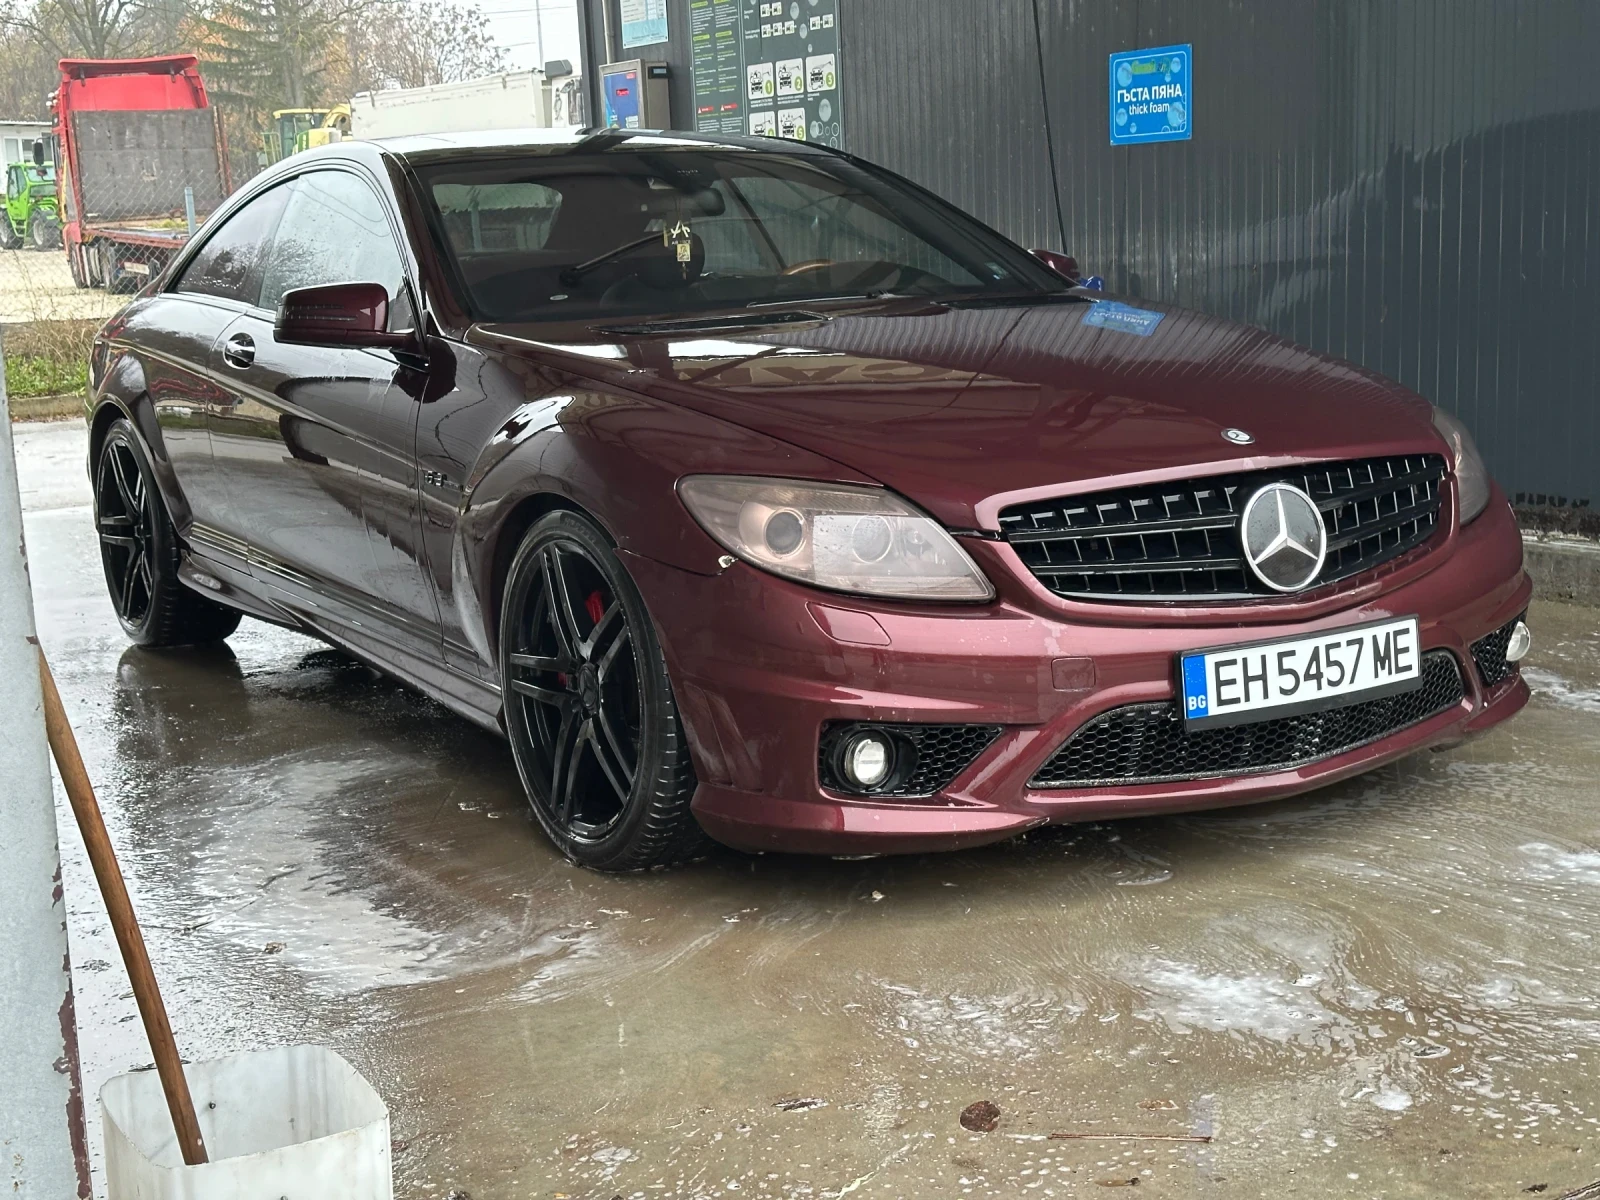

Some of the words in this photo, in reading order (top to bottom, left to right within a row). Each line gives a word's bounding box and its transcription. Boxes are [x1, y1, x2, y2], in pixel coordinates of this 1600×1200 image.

[1117, 87, 1150, 103] ГЪСТА
[1151, 83, 1183, 100] ПЯНА
[1129, 103, 1148, 115] thick
[1149, 102, 1170, 113] foam
[1214, 654, 1269, 707] EH
[1277, 637, 1364, 696] 5457
[1372, 628, 1413, 678] ME
[1188, 694, 1207, 711] BG
